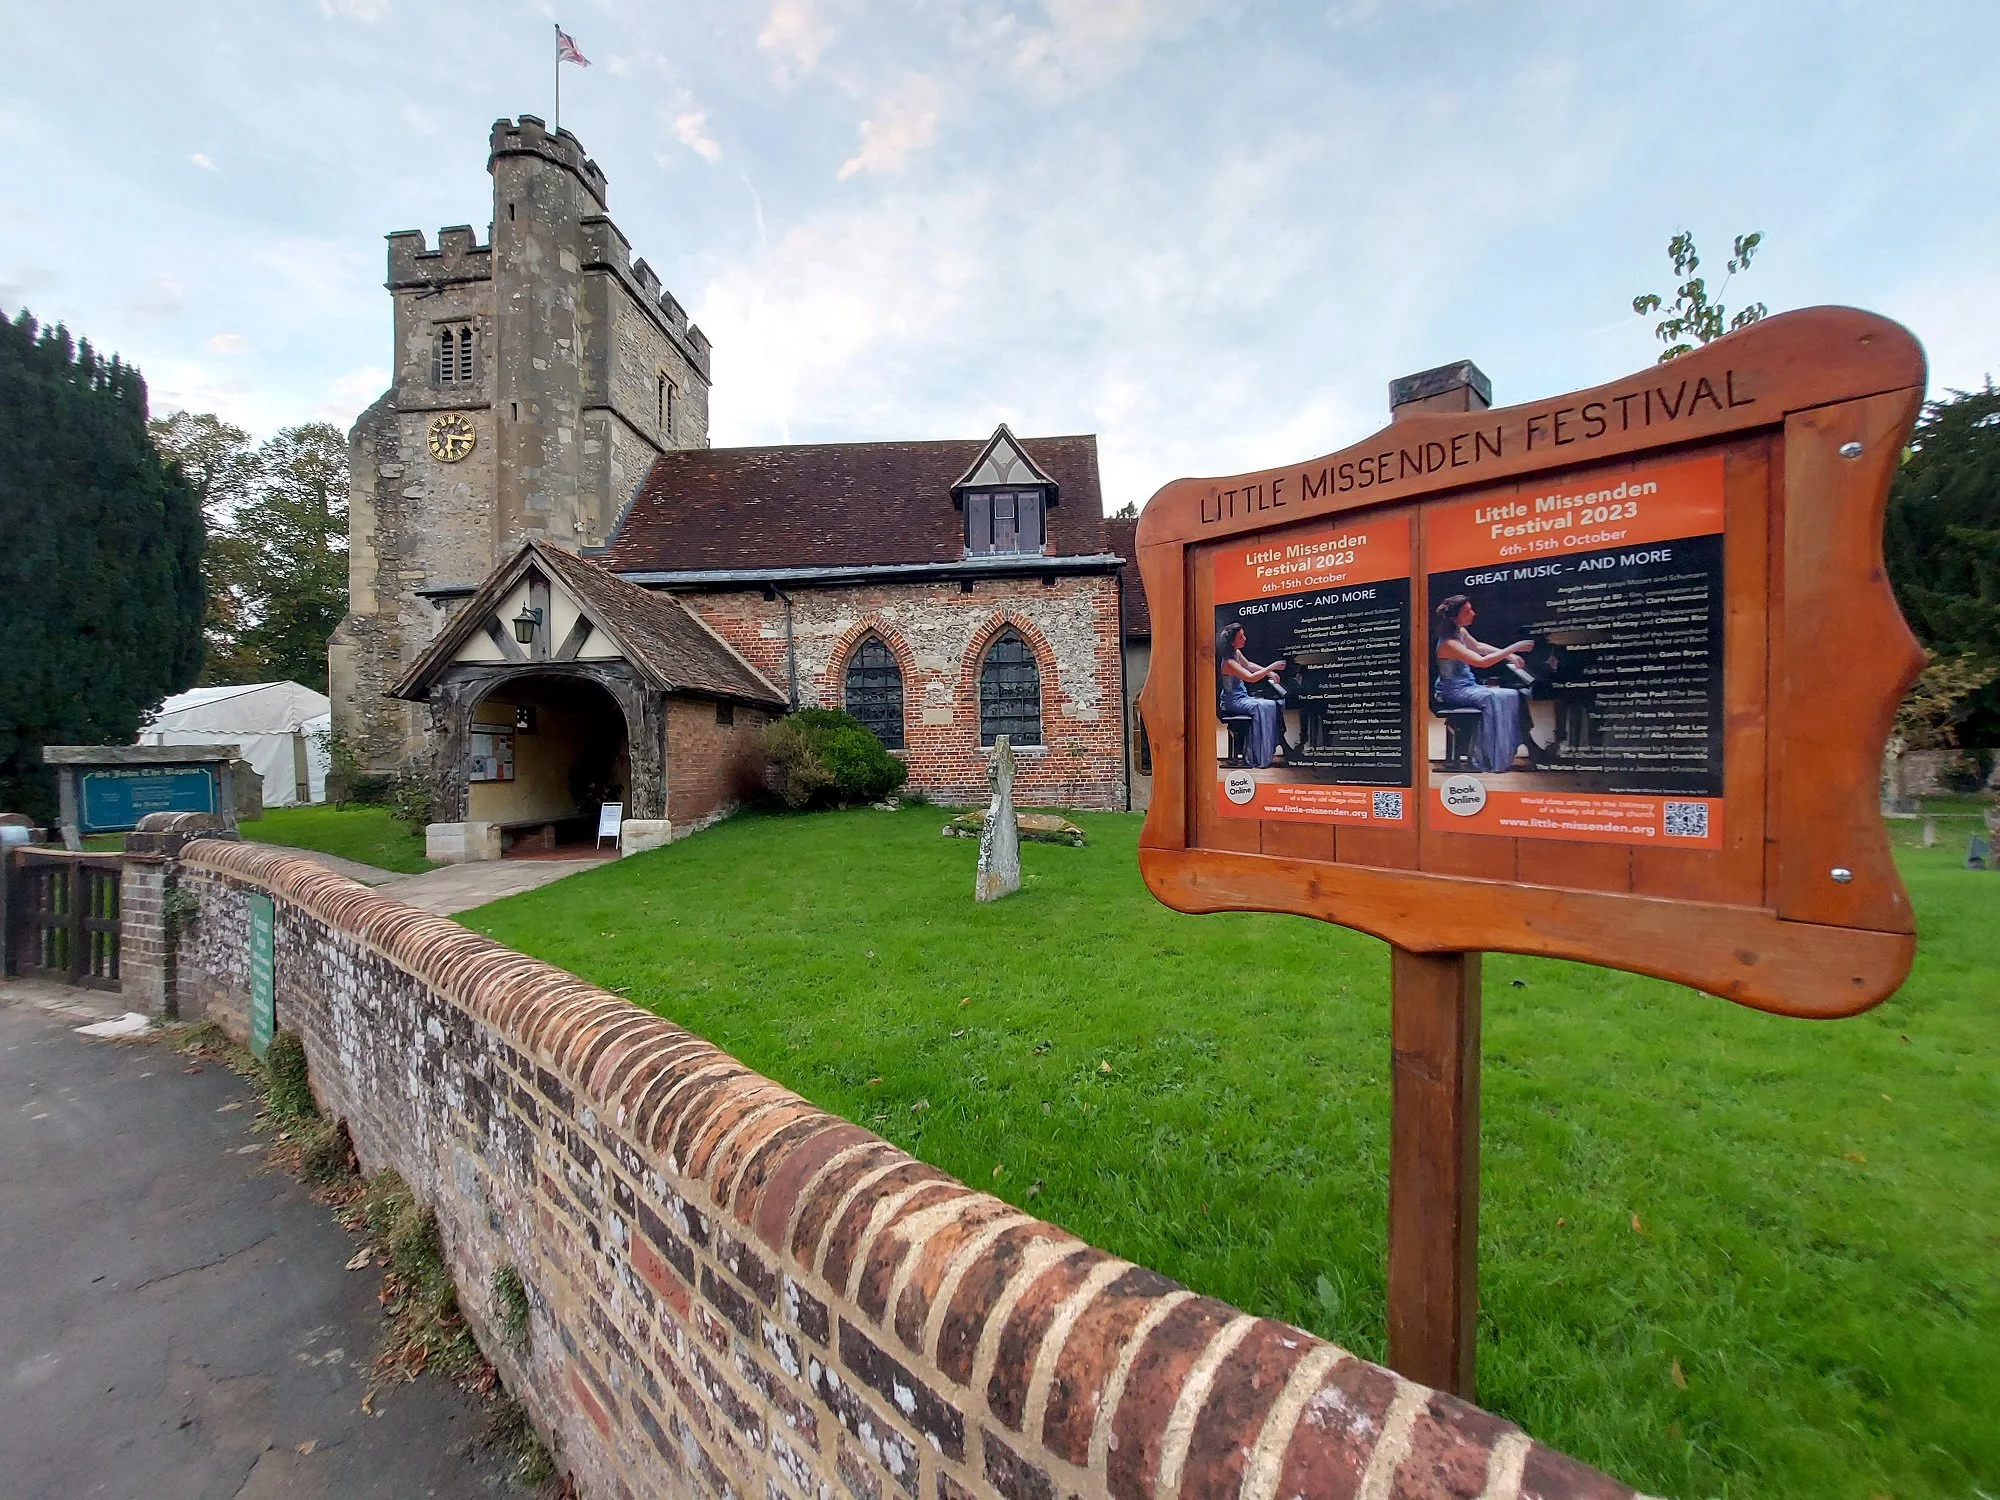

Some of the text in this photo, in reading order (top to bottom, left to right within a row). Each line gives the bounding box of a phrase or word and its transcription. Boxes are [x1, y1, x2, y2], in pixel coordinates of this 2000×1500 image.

[1200, 370, 1756, 524] LITTLE MISSENDEN FESTIVAL
[1475, 482, 1656, 523] Little Missenden
[1491, 502, 1636, 538] Festival 2023
[1246, 535, 1365, 565] Little Missenden
[1499, 530, 1626, 555] 6th-15th October
[1256, 551, 1353, 577] Festival 2023
[1464, 570, 1509, 585] GREAT
[1514, 563, 1561, 579] MUSIC
[1578, 557, 1615, 571] AND
[1620, 549, 1671, 566] MORE
[1262, 572, 1346, 592] 6th-15th October
[1239, 603, 1269, 615] GREAT
[1272, 599, 1303, 611] MUSIC
[1314, 594, 1339, 605] AND
[1342, 589, 1375, 602] MORE
[1229, 786, 1251, 795] Online
[1230, 778, 1248, 786] Book
[1449, 785, 1475, 794] Book
[1447, 794, 1480, 804] Online
[1264, 806, 1367, 818] www.little-missenden.org
[1500, 819, 1654, 836] www.little-missenden.org
